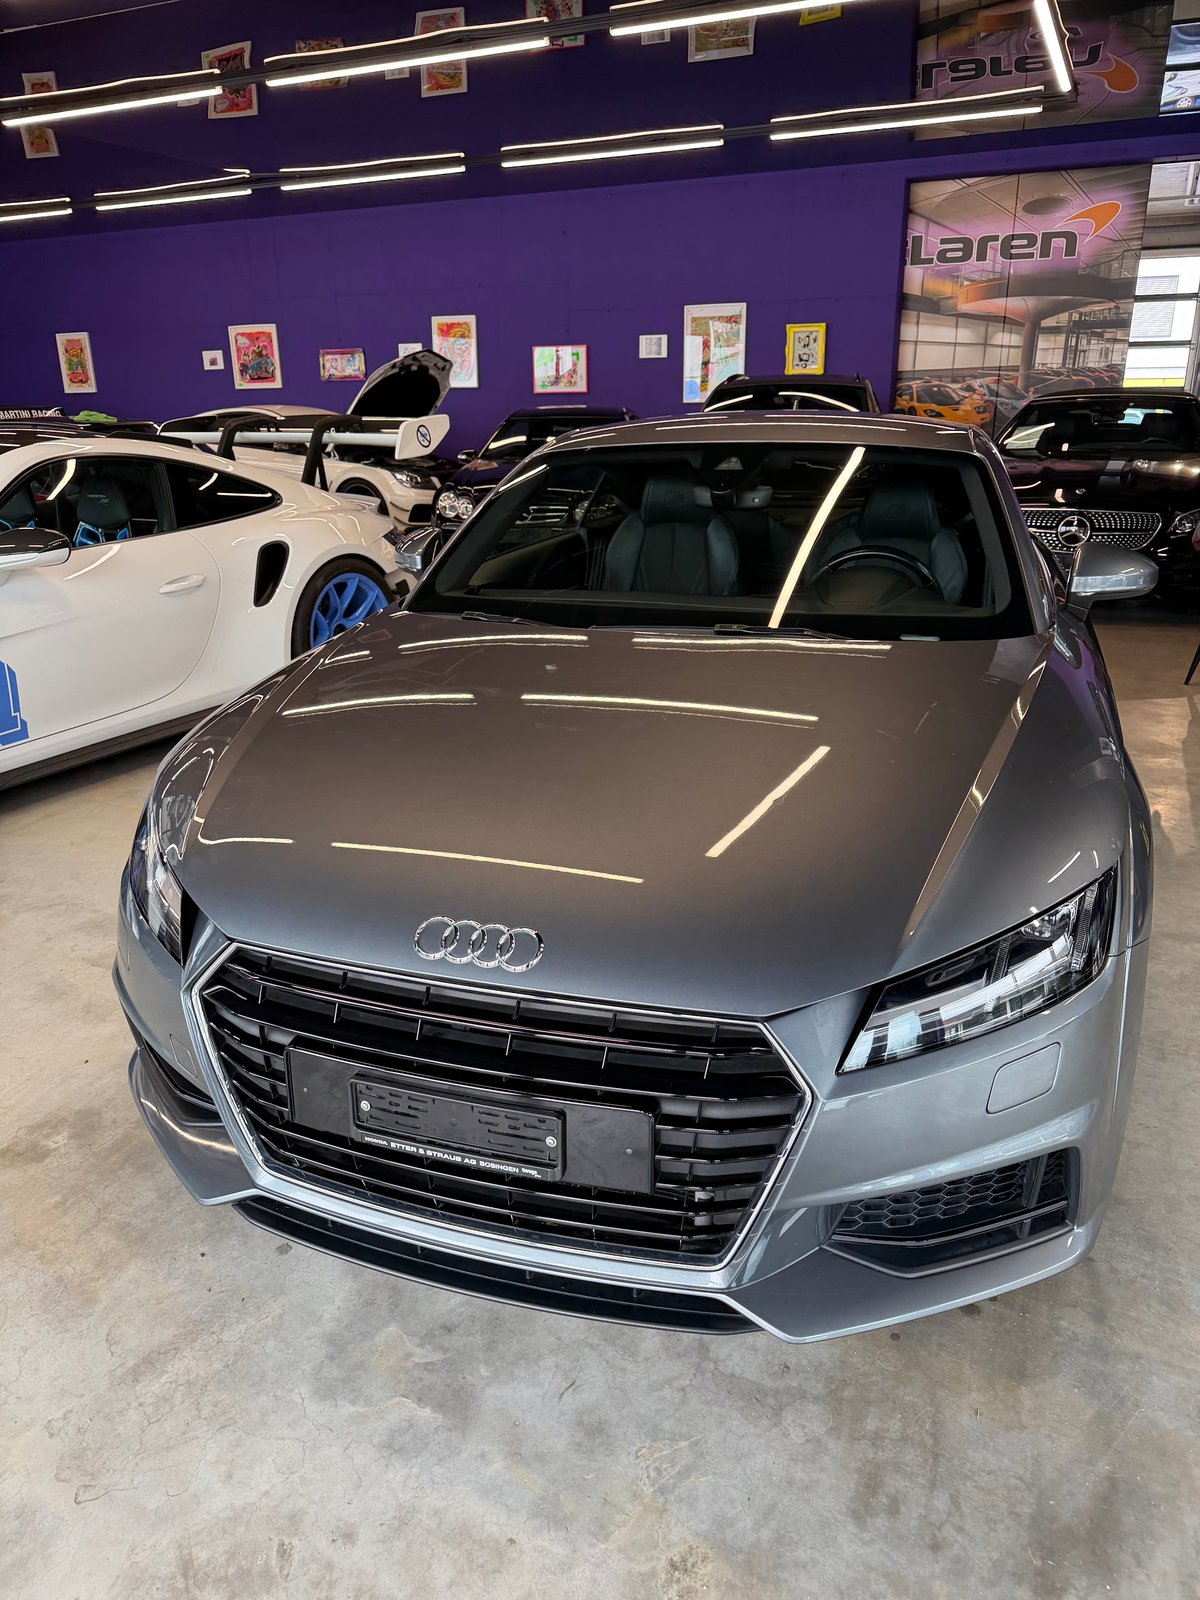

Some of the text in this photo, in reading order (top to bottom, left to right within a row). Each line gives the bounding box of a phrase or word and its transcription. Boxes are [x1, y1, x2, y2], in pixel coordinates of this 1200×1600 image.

[905, 229, 1078, 267] Laren
[390, 1142, 417, 1152] ETTER
[426, 1150, 462, 1162] STRAUB
